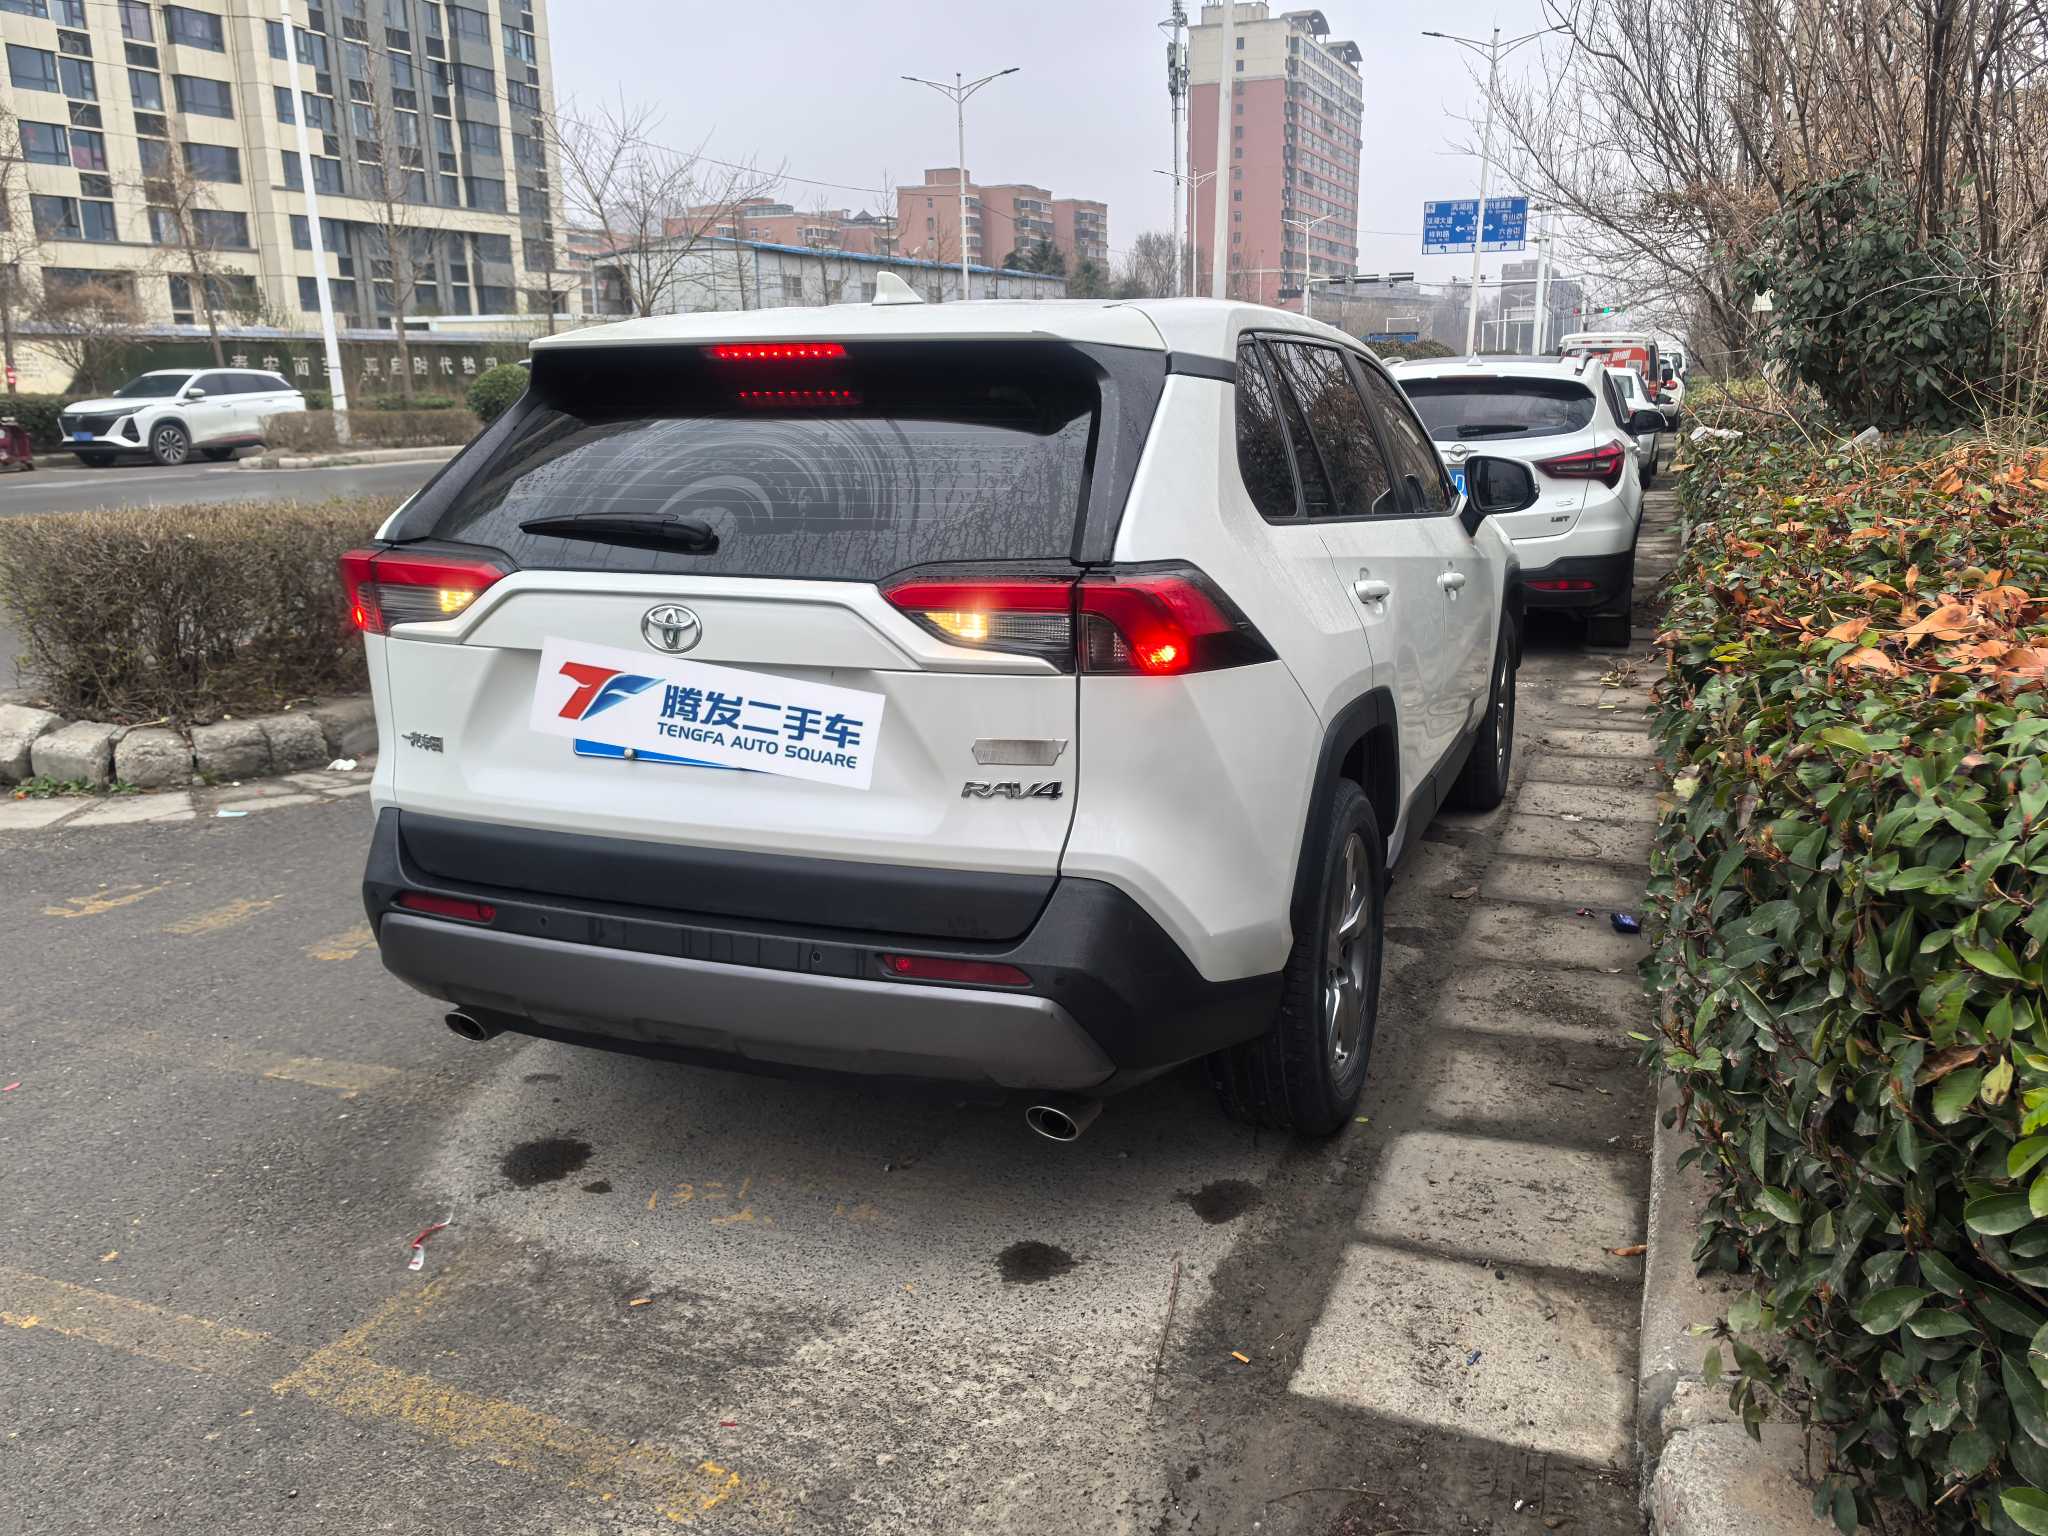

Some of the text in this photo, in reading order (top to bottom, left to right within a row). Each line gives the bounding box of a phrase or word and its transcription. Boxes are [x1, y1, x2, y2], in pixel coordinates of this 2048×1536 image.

[660, 684, 864, 749] 腾发二手车
[657, 721, 858, 769] TENGFA AUTO SQUARE
[961, 780, 1063, 800] RAV4
